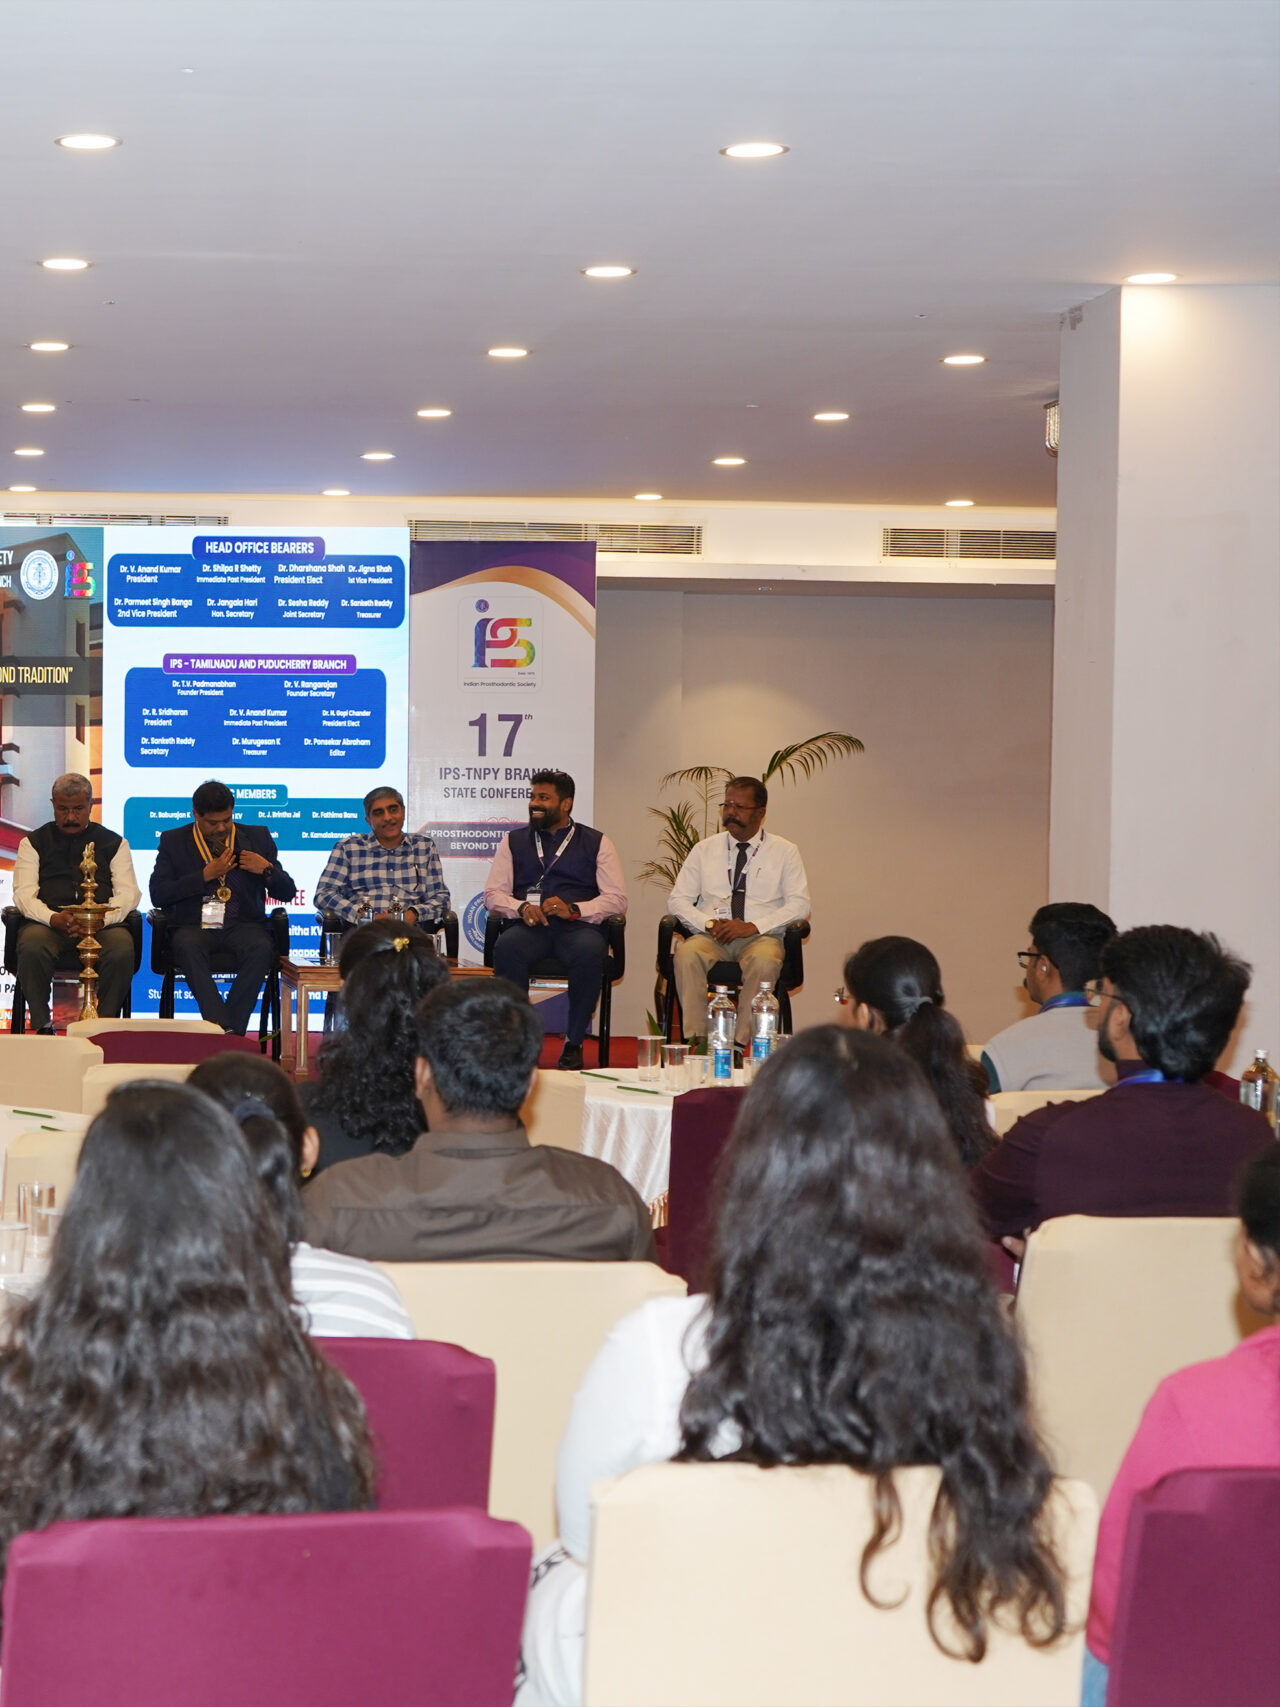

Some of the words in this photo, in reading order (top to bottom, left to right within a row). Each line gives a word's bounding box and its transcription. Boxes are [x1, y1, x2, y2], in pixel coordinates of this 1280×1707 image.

[205, 541, 233, 554] HEAD
[234, 541, 269, 554] OFFICE
[270, 541, 315, 554] BEARERS
[120, 565, 130, 573] Dr.
[130, 565, 136, 573] V.
[137, 565, 159, 573] Anand
[159, 565, 182, 573] Kumar
[202, 564, 212, 572] Dr.
[212, 563, 234, 575] Shilpa
[240, 564, 262, 575] Shetty
[278, 564, 288, 572] Dr.
[288, 564, 326, 573] Dharshana
[327, 564, 346, 573] Shah
[348, 565, 358, 573] Dr.
[358, 565, 375, 575] Jigna
[376, 565, 393, 573] Shah
[126, 574, 158, 583] President
[196, 576, 226, 584] Immediate
[240, 576, 266, 584] President
[274, 575, 306, 584] President
[306, 575, 323, 584] Elect
[114, 598, 124, 606] Dr.
[152, 597, 171, 608] Singh
[244, 598, 258, 606] Hari
[277, 599, 287, 607] Dr.
[308, 599, 329, 609] Reddy
[374, 600, 393, 609] Reddy
[117, 609, 130, 618] 2nd
[131, 609, 146, 618] Vice
[146, 609, 178, 618] President
[225, 610, 255, 620] Secretary
[282, 610, 297, 619] Joint
[298, 610, 326, 620] Secretary
[169, 658, 183, 669] IPS
[190, 658, 238, 669] TAMILNADU
[238, 659, 257, 669] AND
[257, 659, 312, 670] PUDUCHERRY
[312, 659, 347, 670] BRANCH
[172, 680, 181, 688] Dr.
[309, 690, 336, 699] Secretary
[142, 708, 151, 716] Dr.
[266, 709, 288, 717] Kumar
[144, 718, 173, 726] President
[141, 737, 150, 745] Dr.
[176, 737, 196, 747] Reddy
[304, 738, 313, 746] Dr.
[140, 747, 169, 757] Secretary
[329, 748, 346, 756] Editor
[440, 767, 500, 781] IPS-TNPY
[505, 767, 560, 781] BRAN
[236, 789, 277, 799] MEMBERS
[443, 787, 476, 799] STATE
[450, 842, 489, 850] BEYOND
